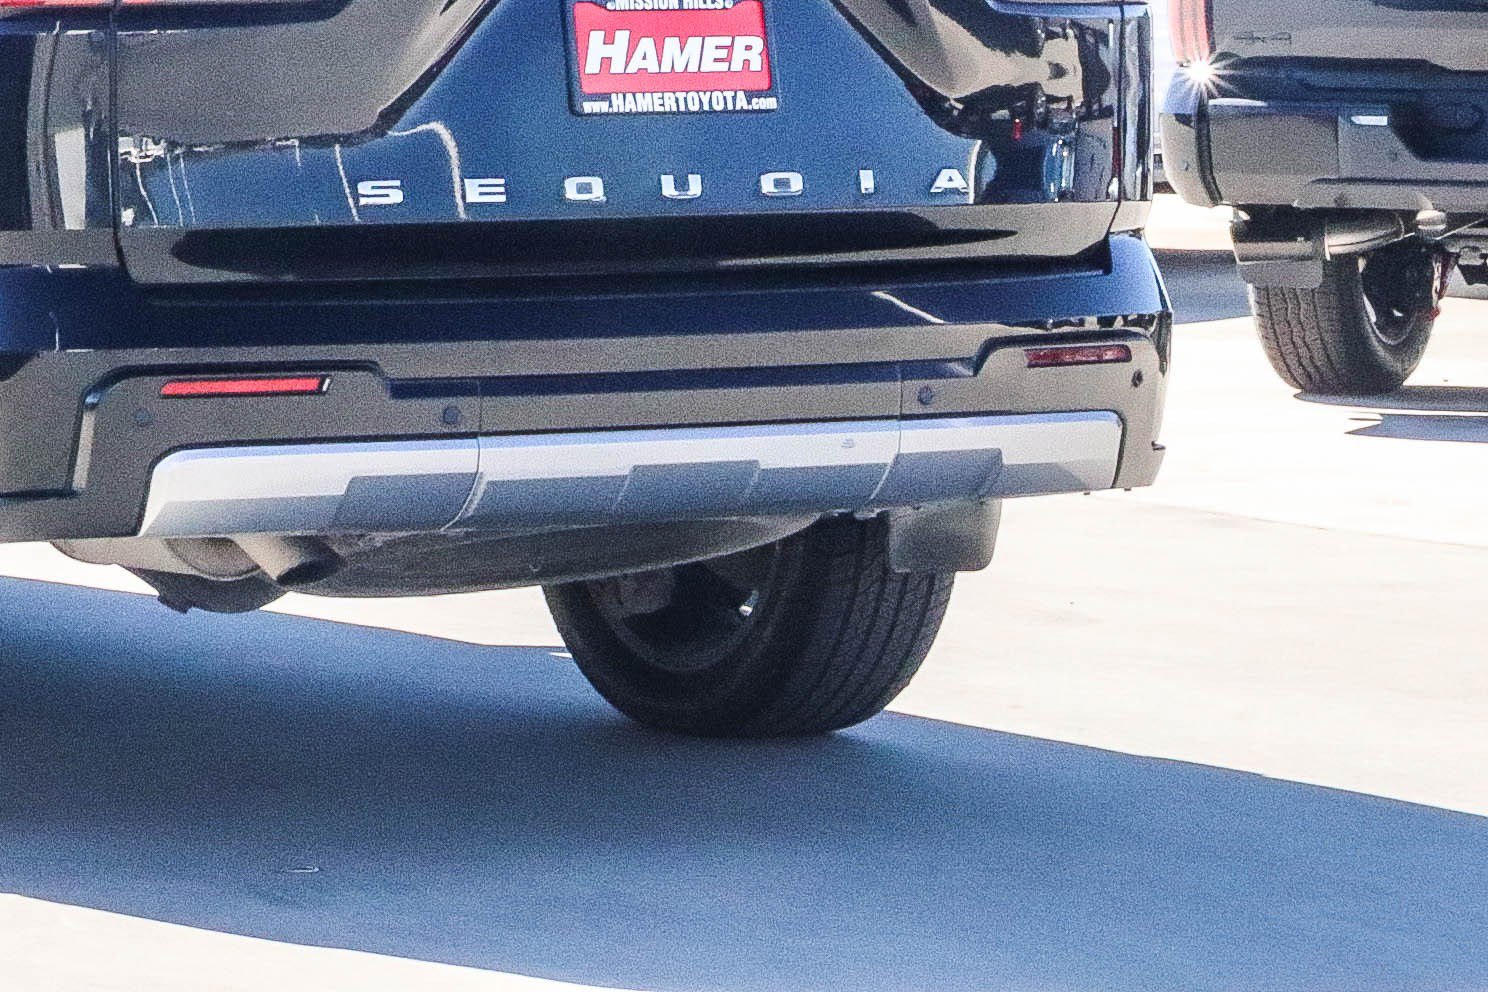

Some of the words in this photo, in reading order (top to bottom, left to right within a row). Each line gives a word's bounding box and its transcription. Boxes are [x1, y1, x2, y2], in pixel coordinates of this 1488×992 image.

[584, 29, 764, 75] HAMER
[582, 90, 778, 114] www.HAMERTOYOTA.com
[357, 168, 970, 205] SEQUOIA
